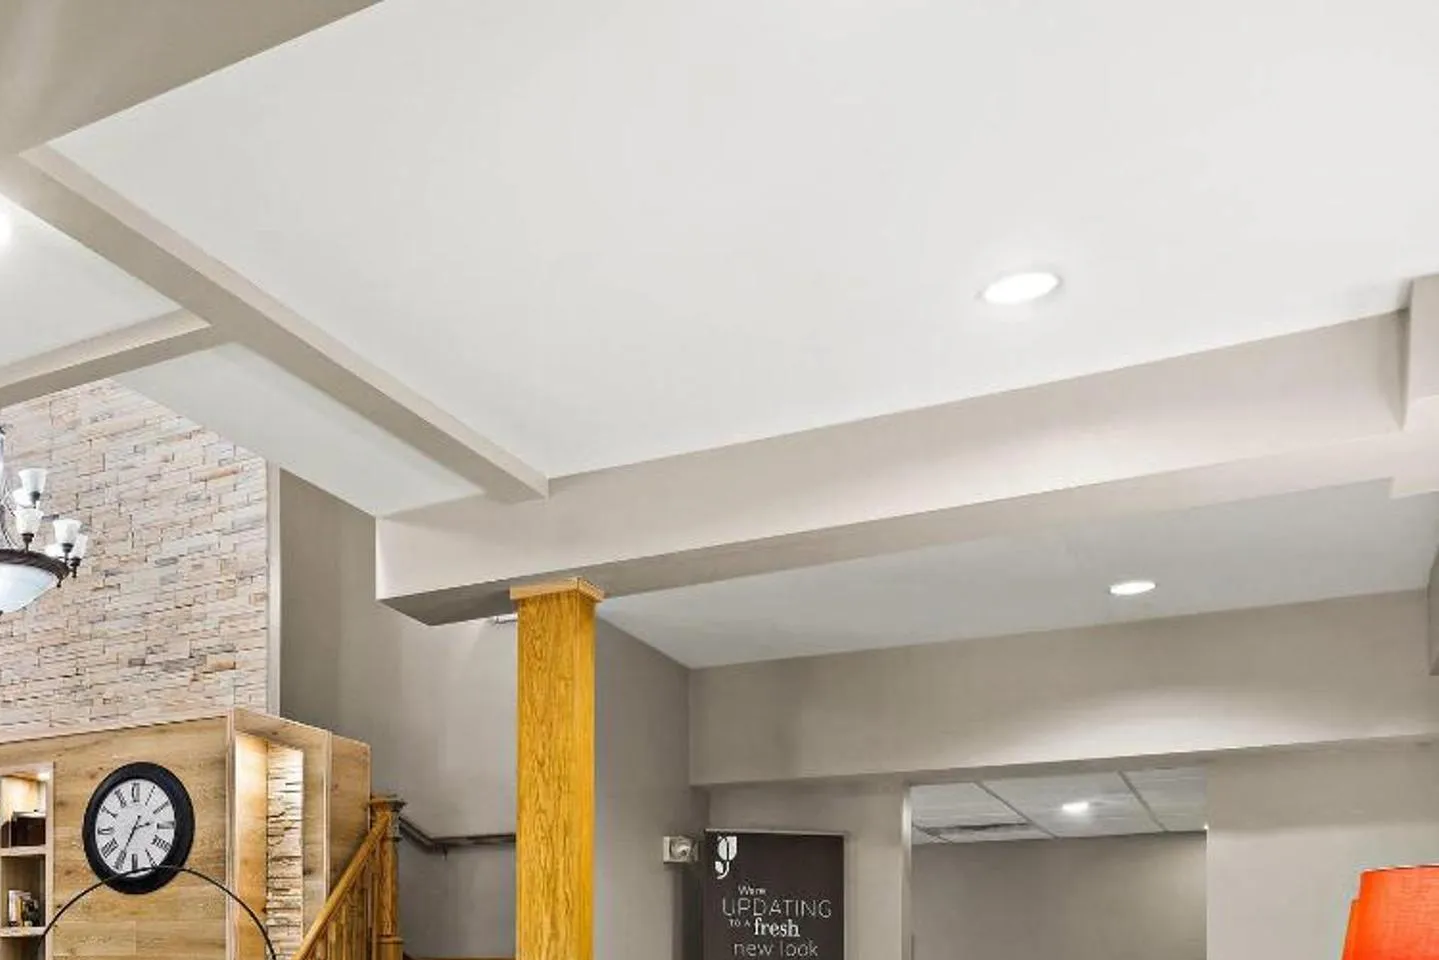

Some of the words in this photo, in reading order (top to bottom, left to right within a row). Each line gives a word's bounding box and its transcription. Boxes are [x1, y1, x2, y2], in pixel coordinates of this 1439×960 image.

[722, 897, 832, 918] UPDATING
[729, 919, 741, 928] TO
[744, 919, 751, 928] A
[754, 917, 800, 937] fresh
[733, 941, 774, 957] new
[779, 940, 819, 957] look
